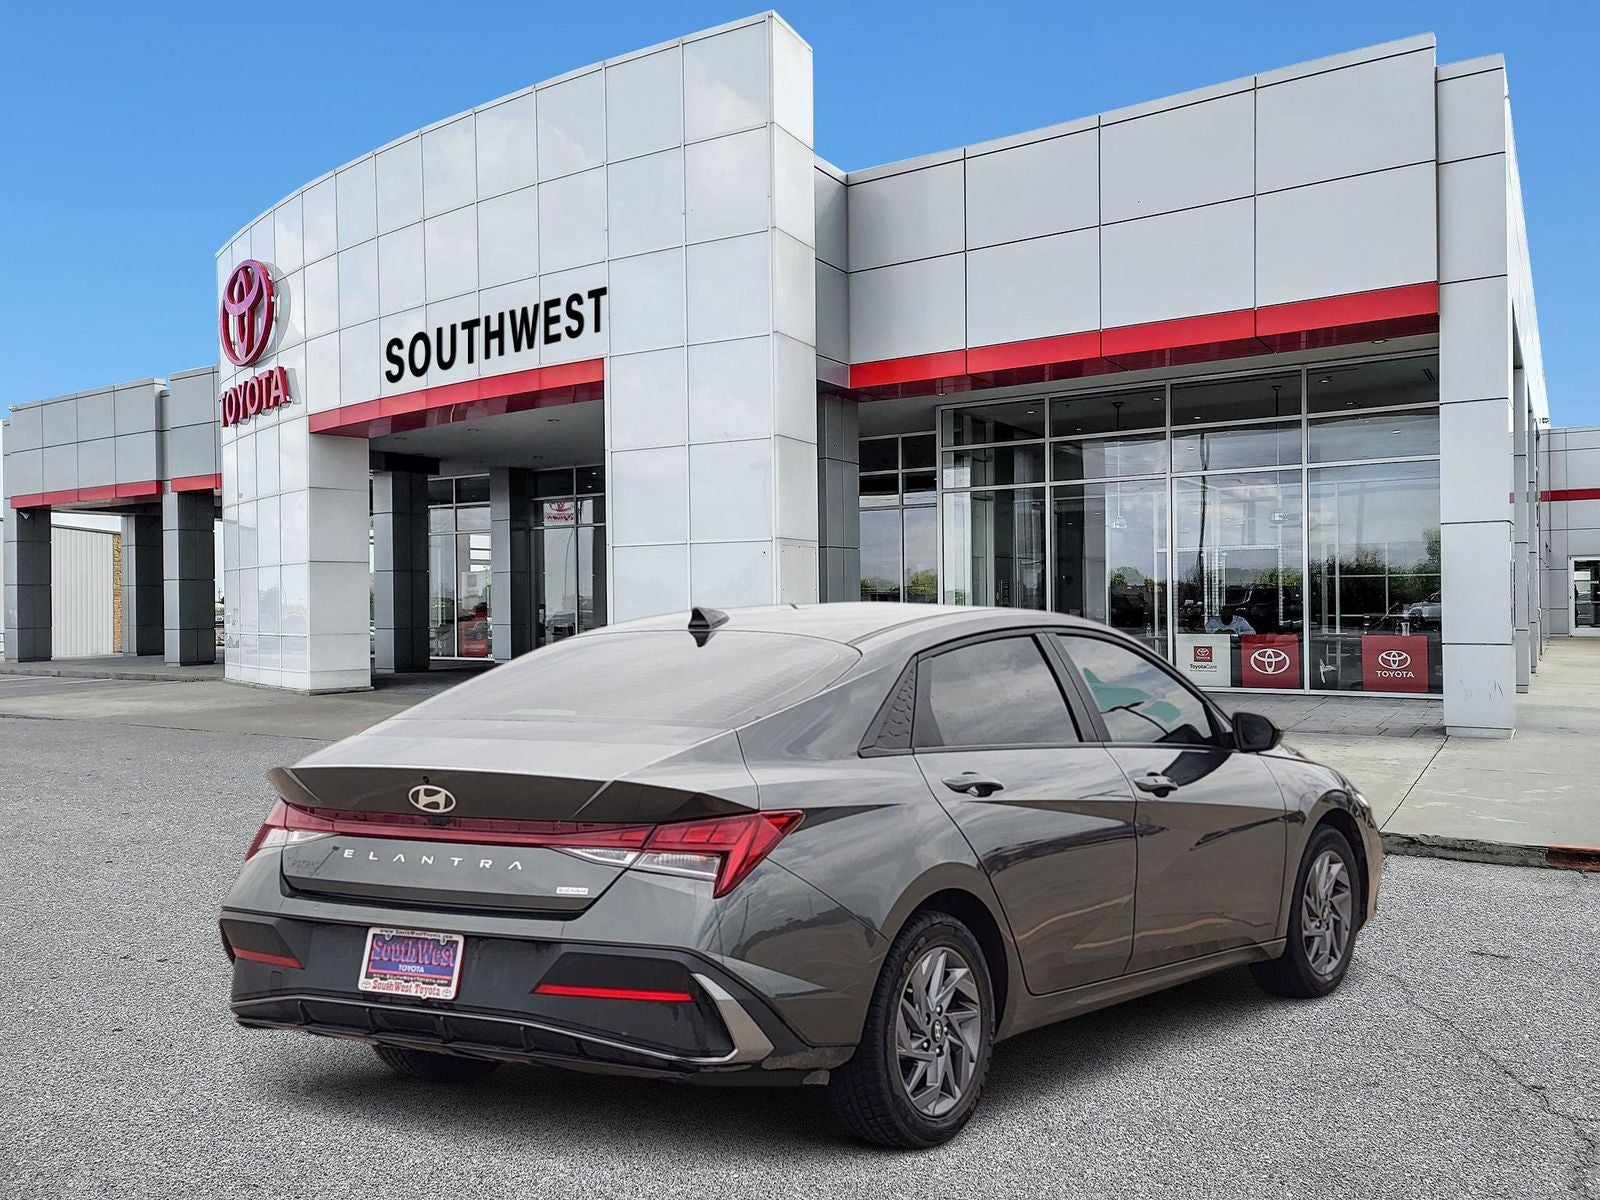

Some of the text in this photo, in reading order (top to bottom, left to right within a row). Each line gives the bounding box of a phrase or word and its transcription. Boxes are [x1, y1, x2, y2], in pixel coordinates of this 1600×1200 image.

[385, 286, 608, 384] SOUTHWEST
[218, 366, 291, 428] TOYOTA
[1376, 670, 1415, 679] TOYOTA
[343, 848, 523, 871] ELANTRA
[371, 937, 456, 967] SouthWest
[398, 963, 425, 973] TOYOTA
[372, 978, 441, 997] SouthWest Toyota
